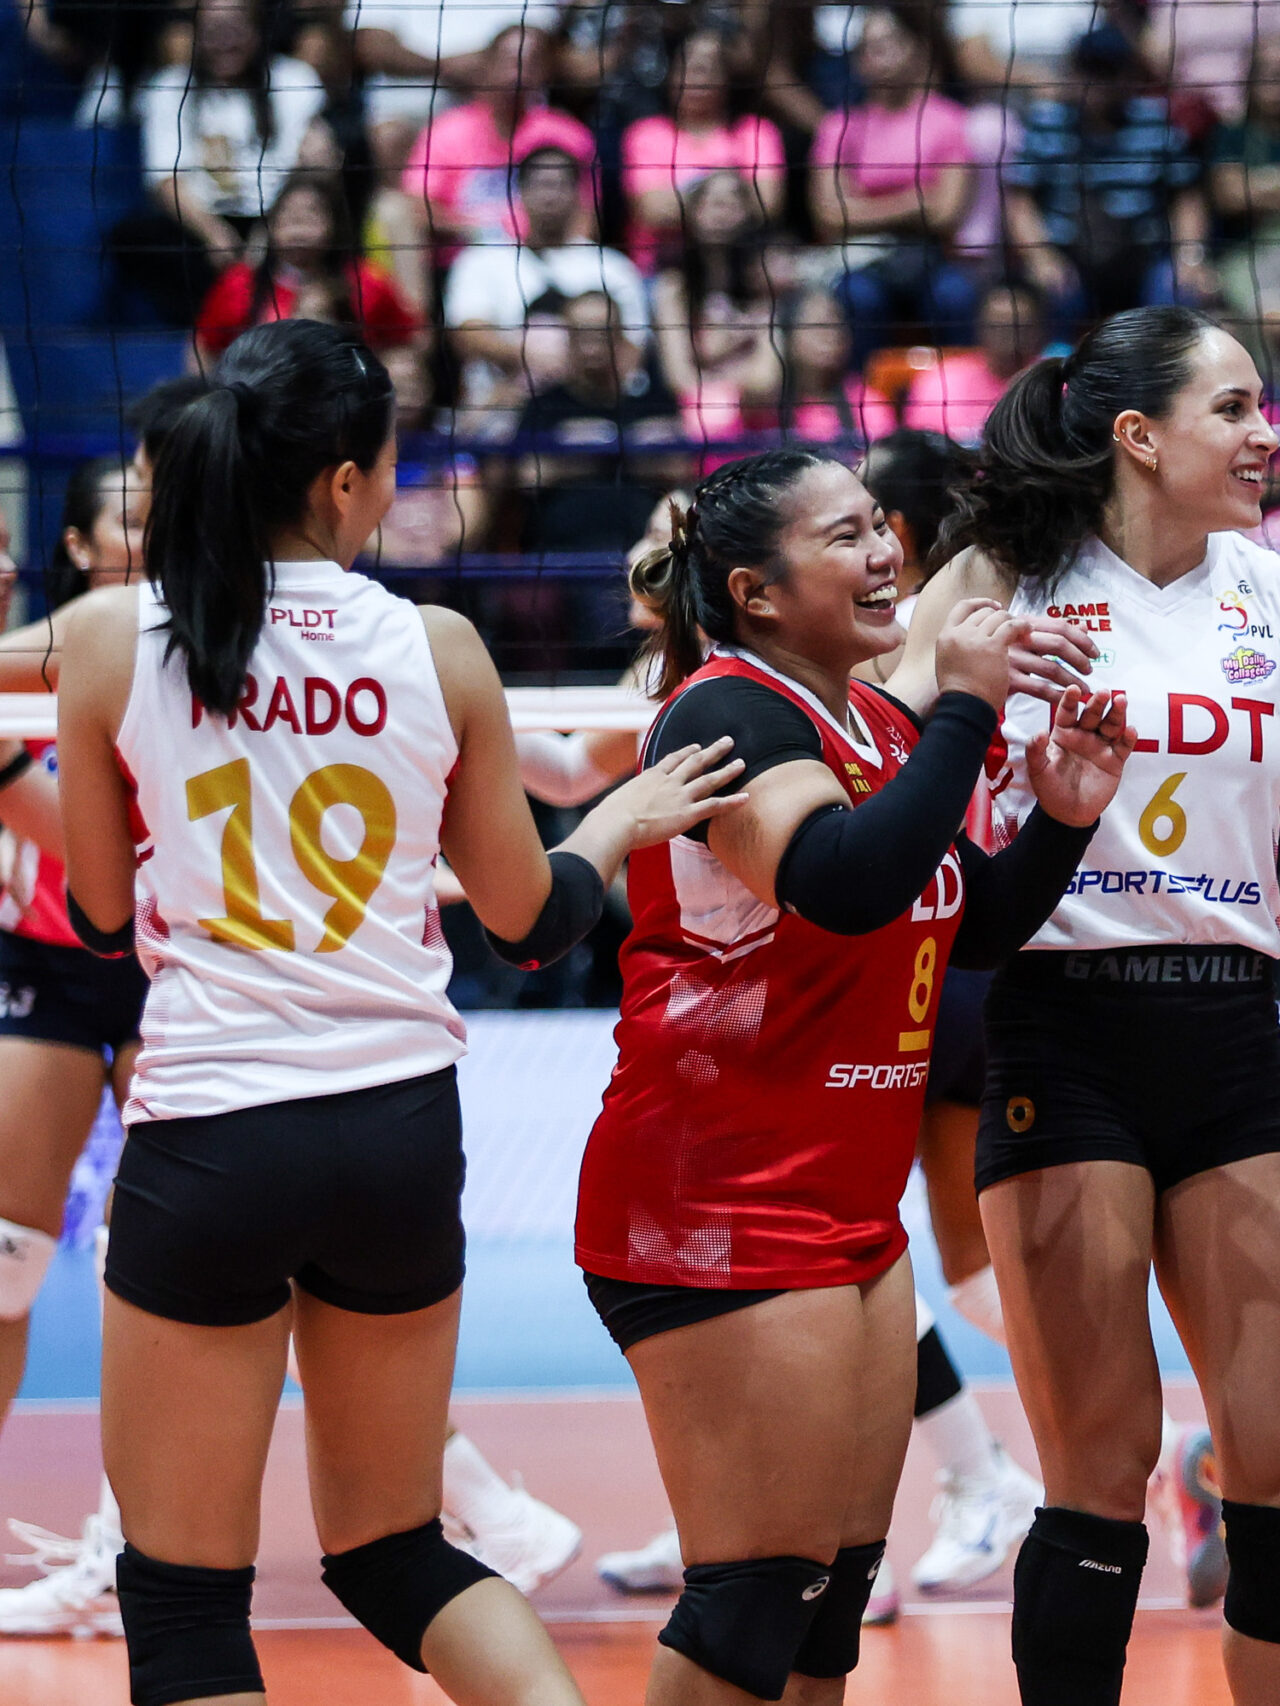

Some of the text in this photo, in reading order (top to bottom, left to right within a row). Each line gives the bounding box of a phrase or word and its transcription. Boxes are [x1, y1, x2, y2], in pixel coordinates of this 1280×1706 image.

[269, 607, 339, 629] PLDT
[1046, 603, 1110, 619] GAME
[301, 631, 336, 642] Home
[1250, 624, 1274, 639] PVL
[191, 671, 388, 737] RADO
[1138, 772, 1188, 857] 6
[185, 757, 397, 954] 19
[908, 937, 937, 1024] 8
[1063, 951, 1264, 984] GAMEVILLE
